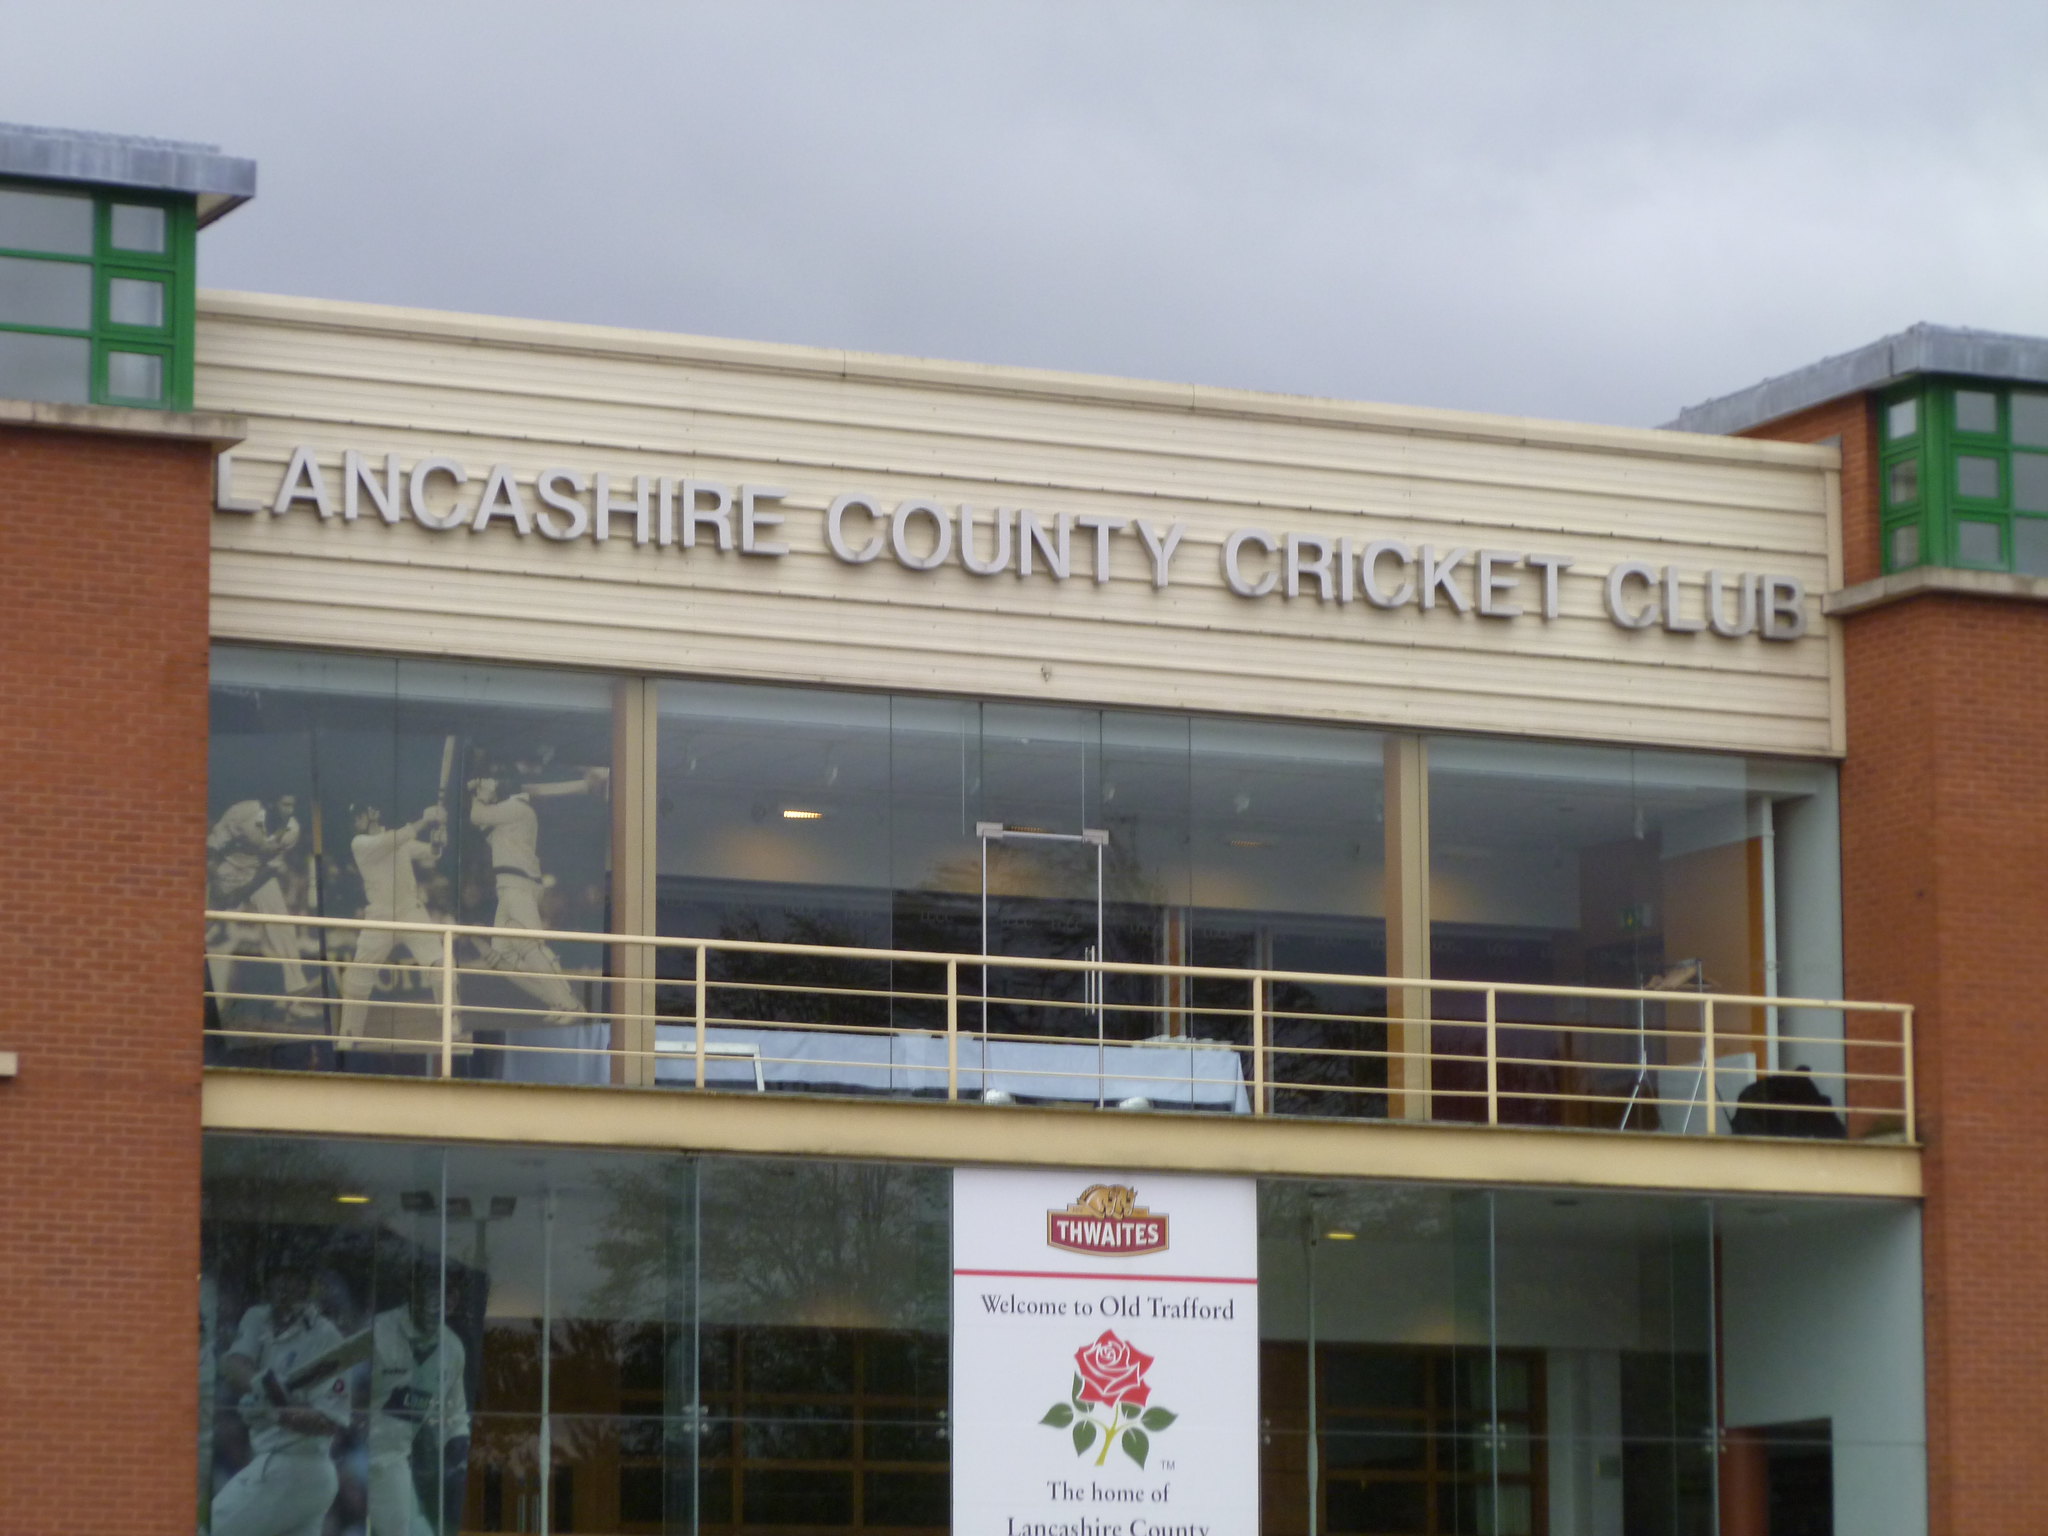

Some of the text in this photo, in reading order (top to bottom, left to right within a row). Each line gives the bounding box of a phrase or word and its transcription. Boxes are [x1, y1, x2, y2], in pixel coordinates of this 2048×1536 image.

[216, 445, 1808, 642] LANCASHIRE COUNTY CRICKET CLUB
[1056, 1219, 1160, 1247] THWAITES
[981, 1294, 1235, 1321] Welcome to Old Trafford
[1047, 1481, 1171, 1504] The home of
[1007, 1516, 1210, 1536] Lancashire County
